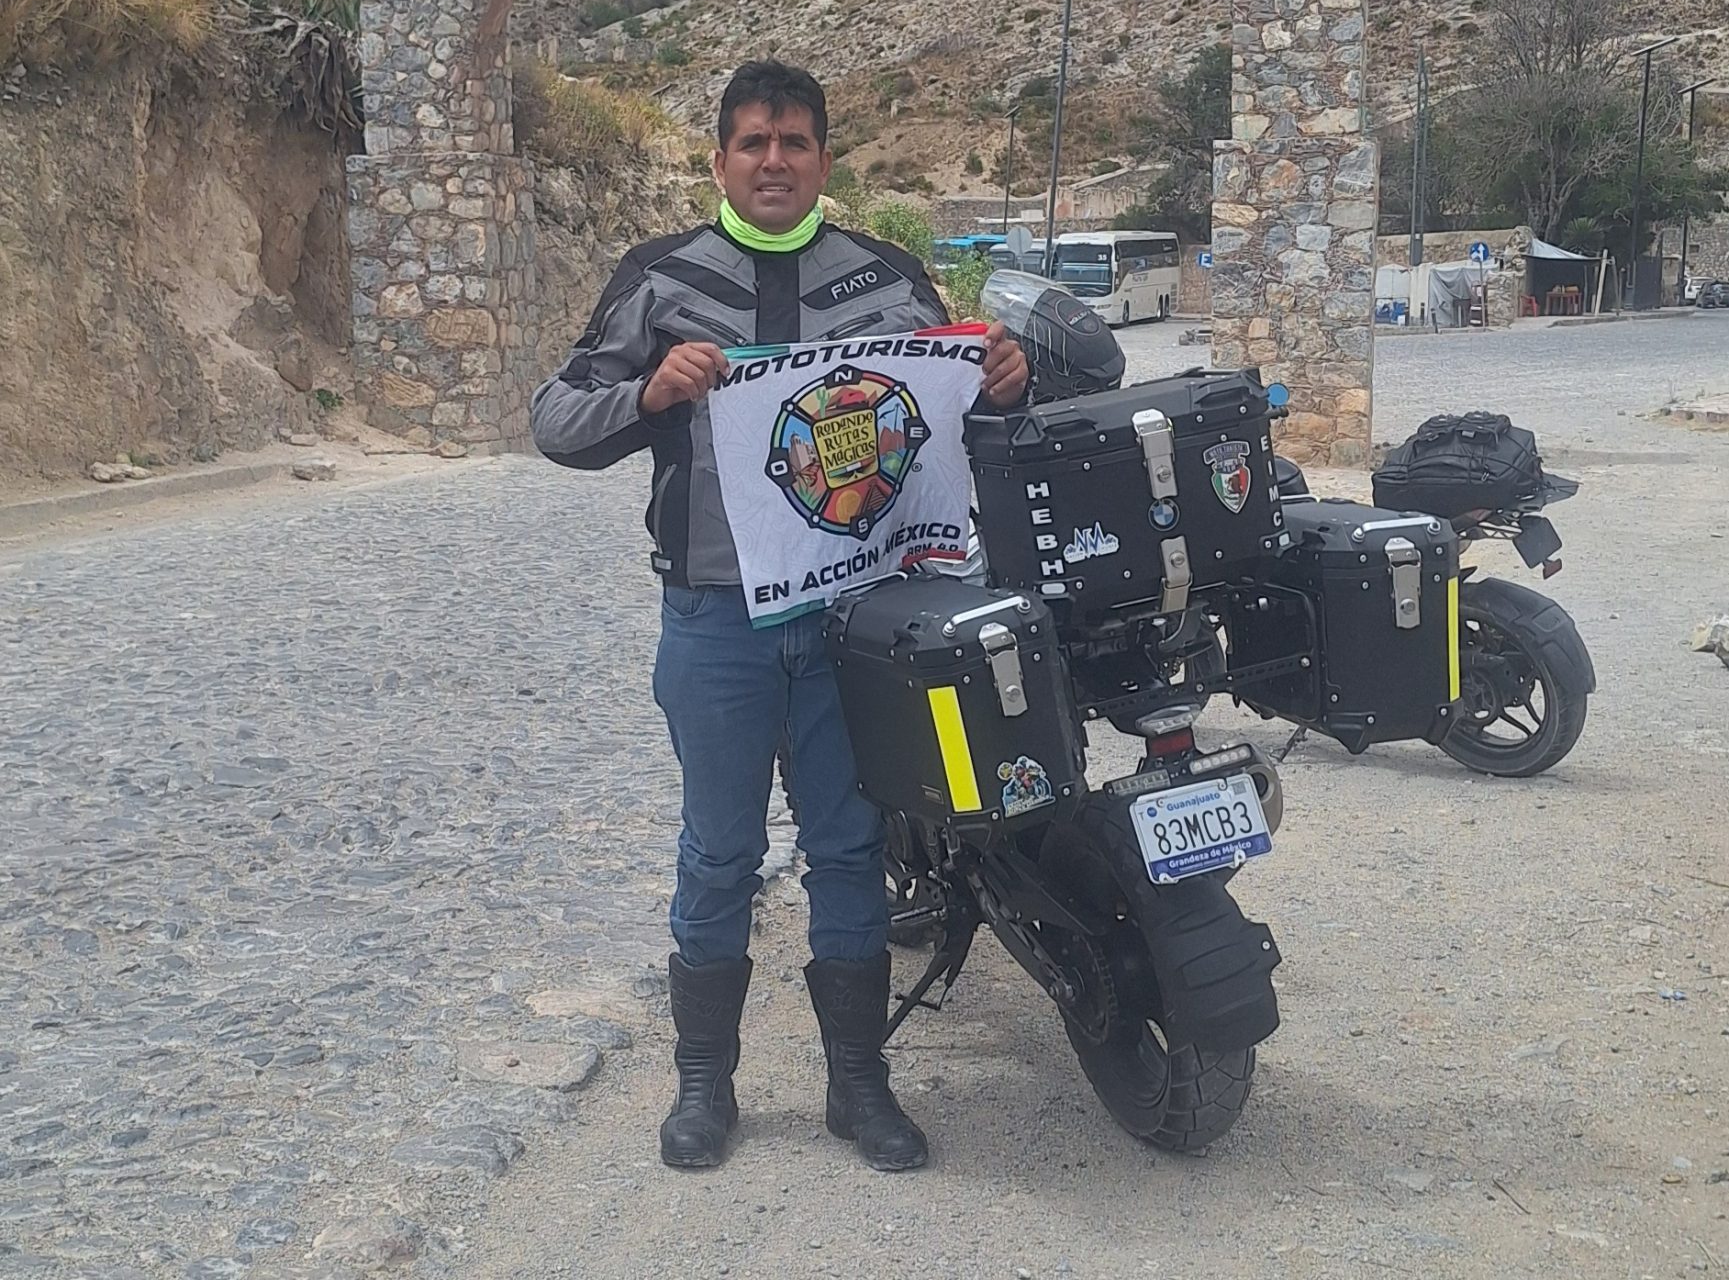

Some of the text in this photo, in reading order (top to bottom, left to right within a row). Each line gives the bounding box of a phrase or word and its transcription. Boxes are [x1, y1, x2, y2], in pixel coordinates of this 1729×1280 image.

[830, 271, 878, 300] FIATO
[713, 338, 988, 392] MOTOTURISMO
[834, 369, 853, 383] N
[910, 426, 924, 438] E
[857, 519, 869, 533] S
[755, 522, 961, 604] EN ACCIÓN MÉXICO
[1166, 791, 1221, 812] Guanajuato
[1153, 801, 1253, 855] 83MCB3
[1168, 850, 1209, 869] Grandeza
[1210, 847, 1222, 859] de
